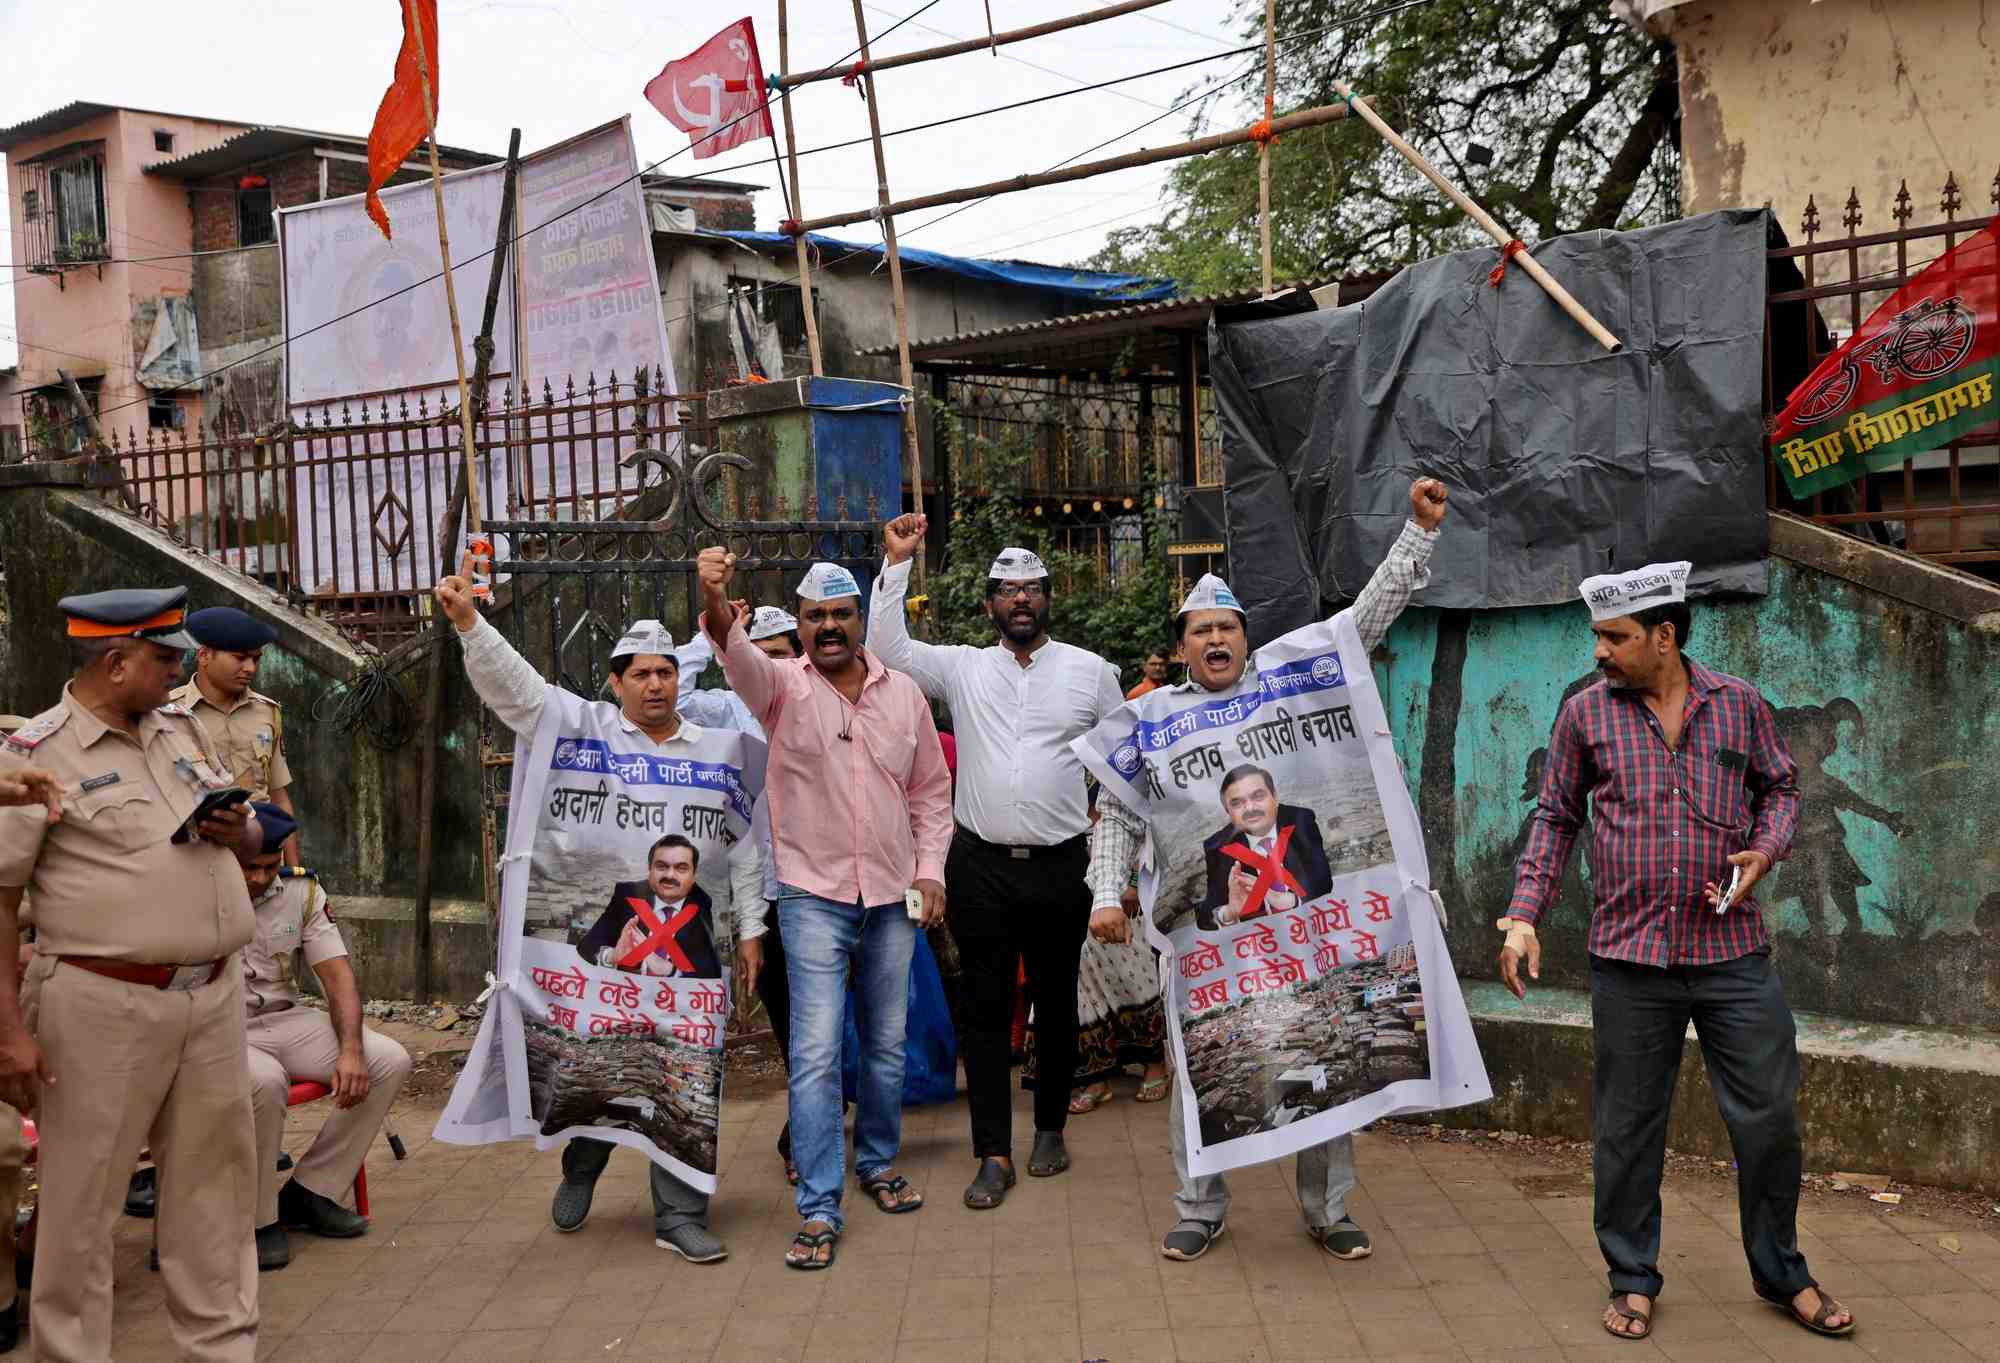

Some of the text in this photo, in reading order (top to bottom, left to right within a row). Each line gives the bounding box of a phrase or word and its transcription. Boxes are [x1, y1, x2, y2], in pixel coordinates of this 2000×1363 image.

[1590, 585, 1621, 603] आम
[1151, 712, 1198, 749] आदमी
[1203, 698, 1244, 725] पार्टी
[1169, 742, 1226, 789] हटाव
[1236, 706, 1298, 761] धारावी
[1297, 704, 1356, 748] बचाव
[657, 763, 693, 785] पार्टी
[549, 779, 610, 824] अदानी
[616, 794, 669, 832] हटाव
[1179, 941, 1224, 979] पहले
[1231, 923, 1279, 959] लडे
[1286, 915, 1310, 944] थे
[1362, 890, 1393, 921] से
[530, 966, 588, 999] पहले
[600, 976, 641, 1009] लडे
[655, 981, 678, 1012] थे
[1186, 979, 1228, 1011] अब
[1236, 954, 1308, 994] लडेंगे
[1351, 930, 1379, 960] से
[547, 1003, 580, 1031] अब
